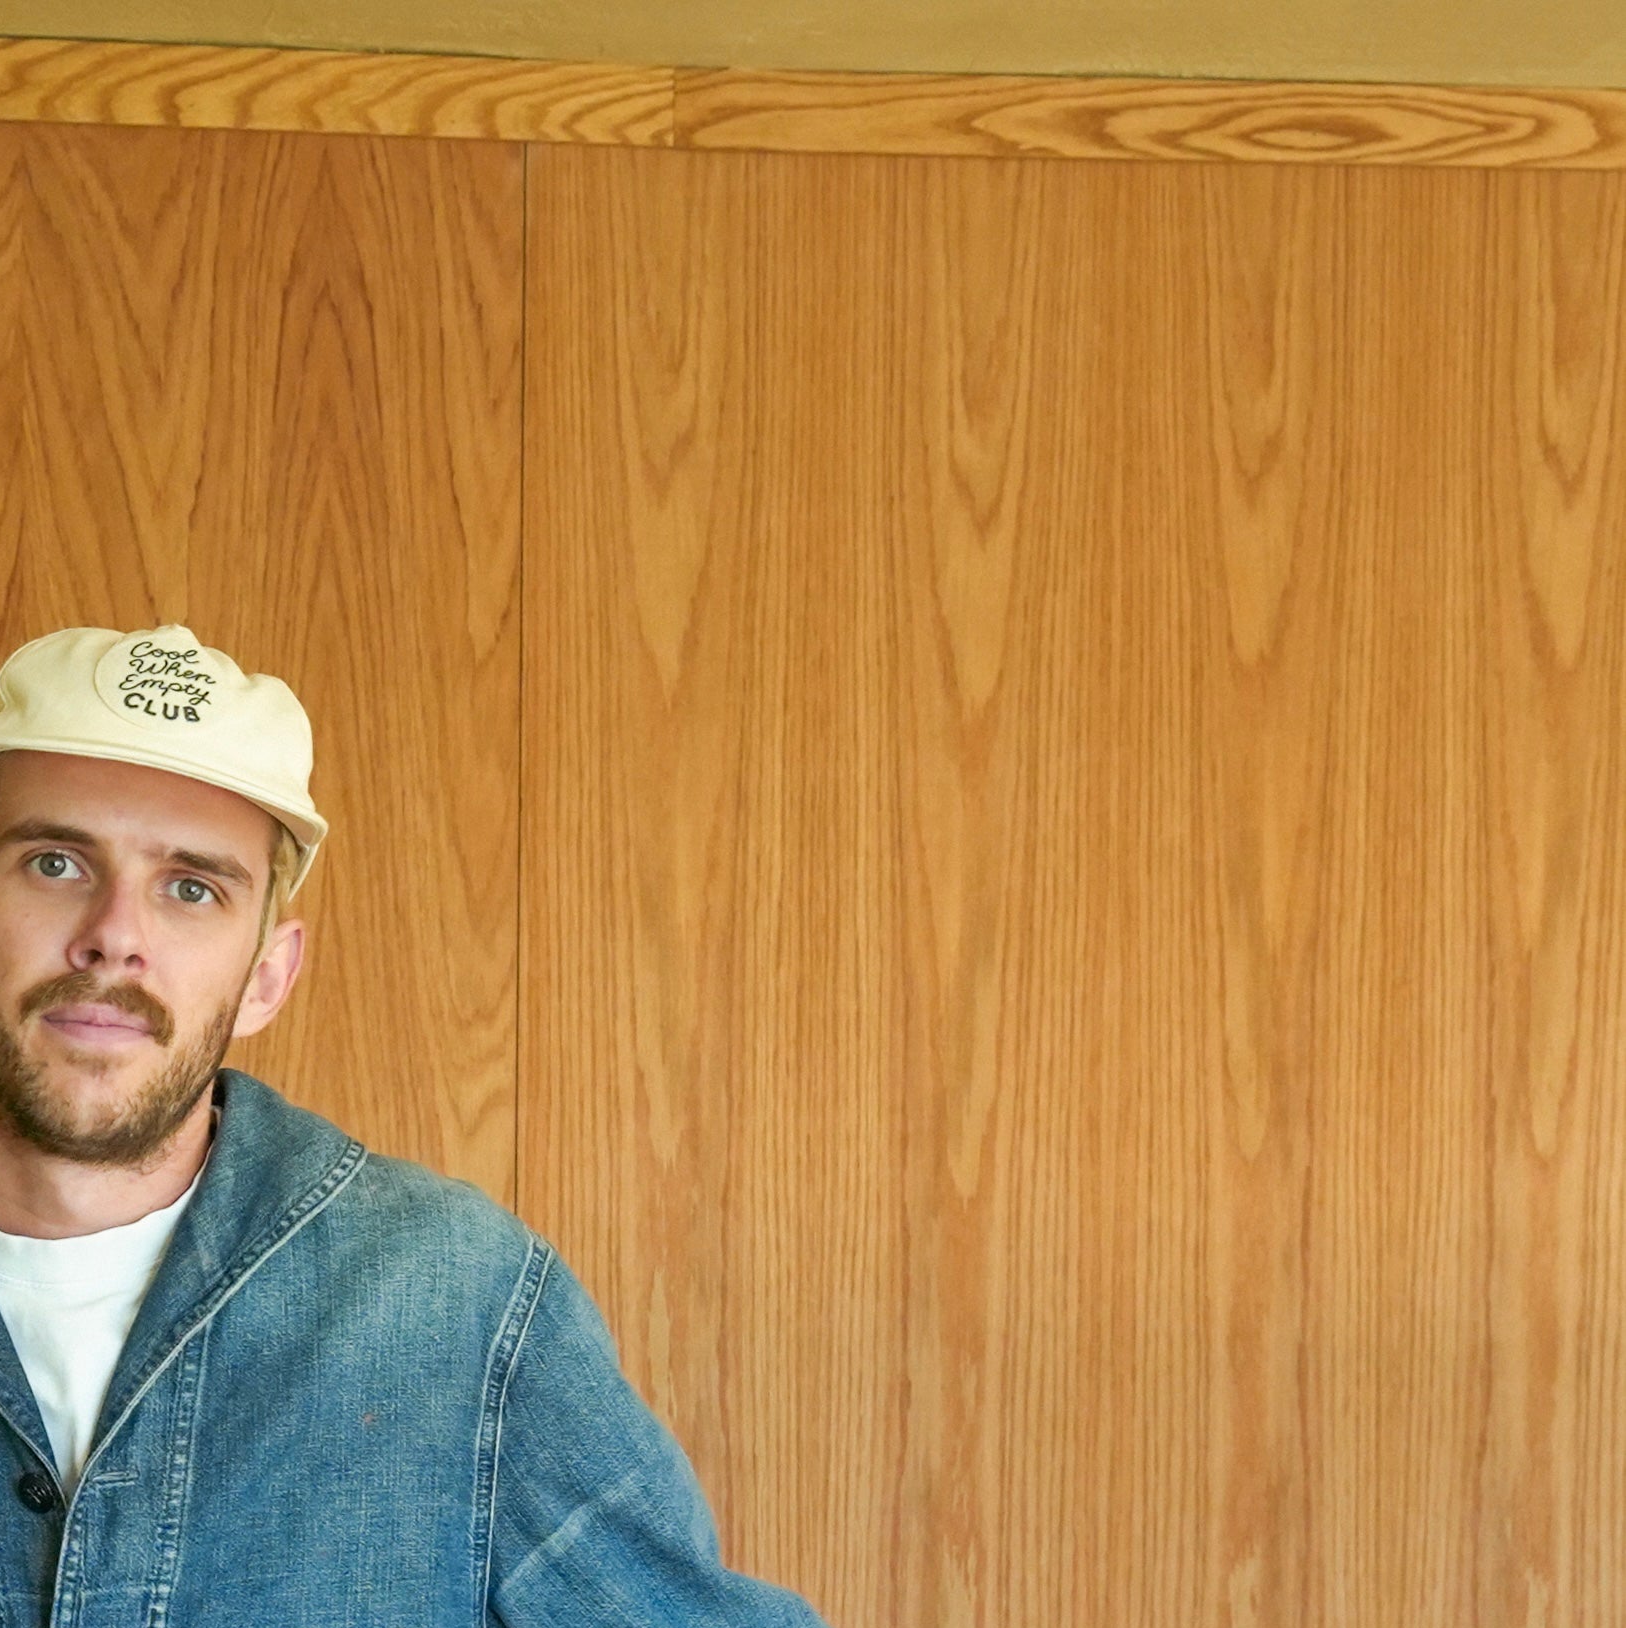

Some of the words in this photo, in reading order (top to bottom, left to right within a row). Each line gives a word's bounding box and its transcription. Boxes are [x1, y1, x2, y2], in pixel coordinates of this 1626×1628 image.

[130, 641, 200, 664] Cool
[129, 659, 216, 685] When
[119, 674, 211, 705] Empty
[123, 692, 200, 722] CLUB
